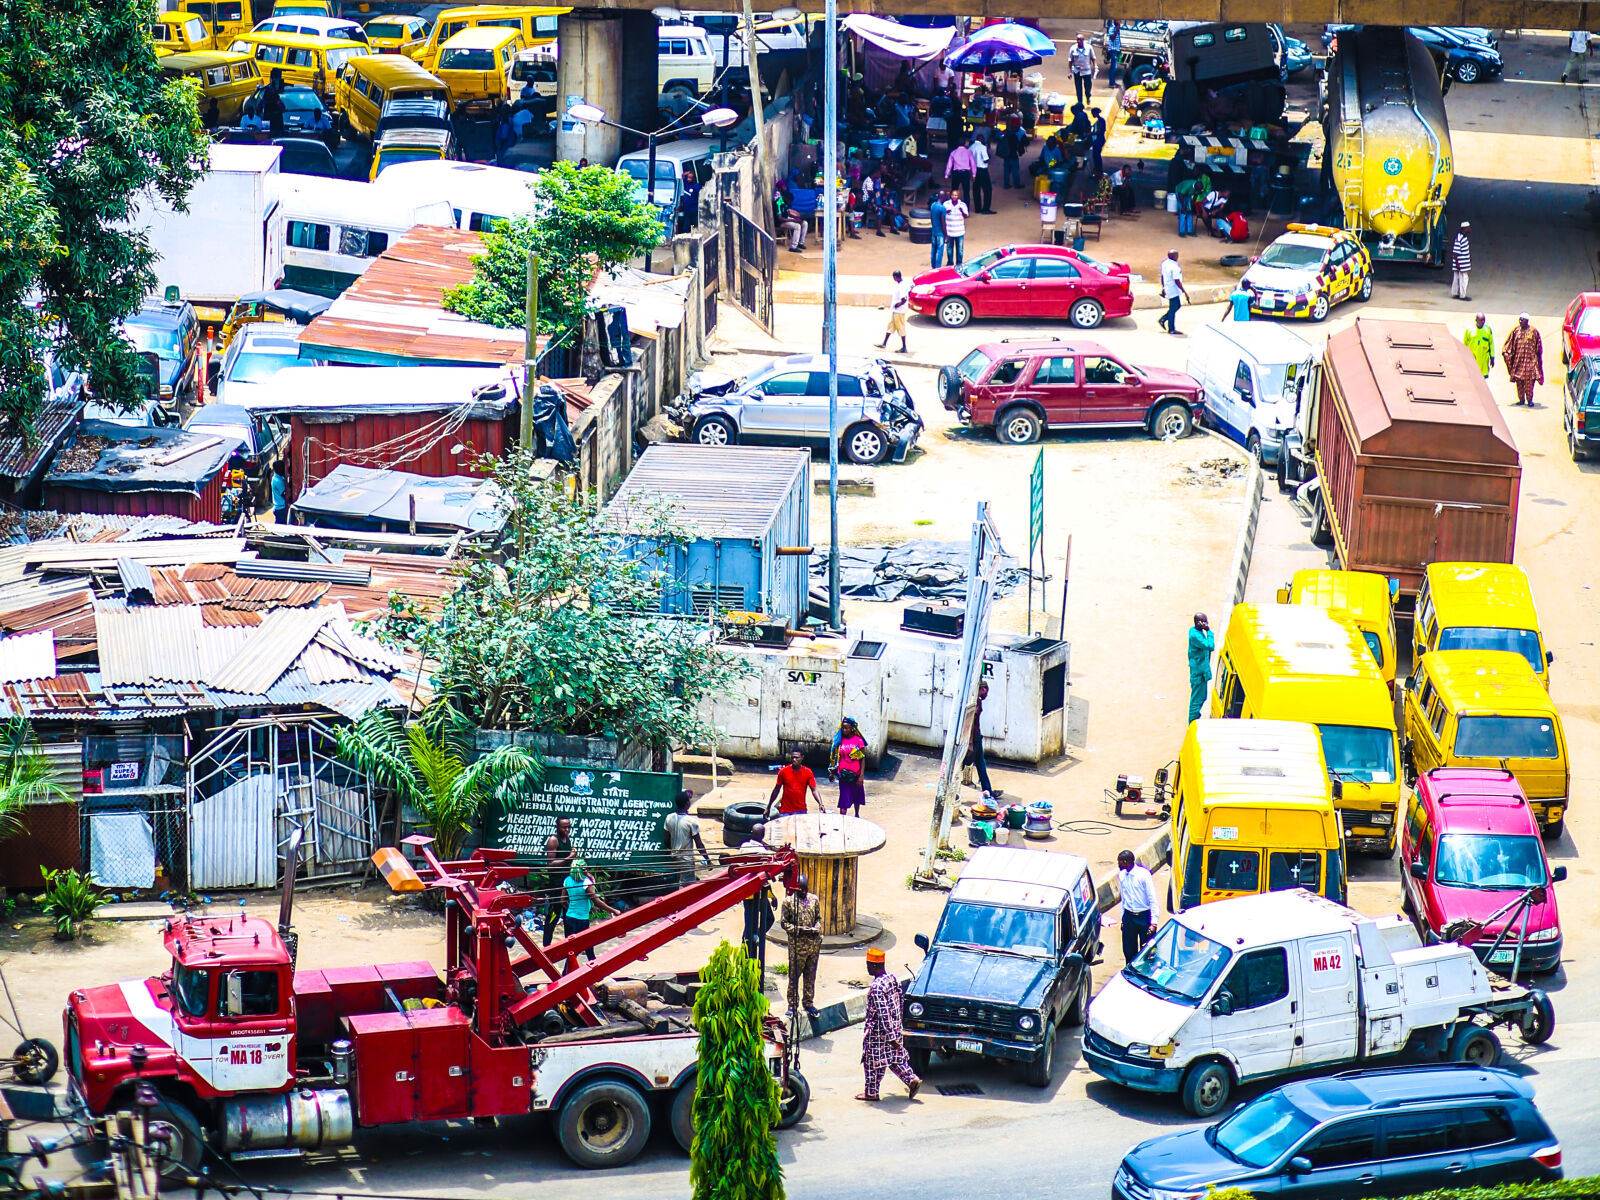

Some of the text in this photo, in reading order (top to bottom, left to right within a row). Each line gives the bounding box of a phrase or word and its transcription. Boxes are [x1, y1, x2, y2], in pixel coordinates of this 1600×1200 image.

[1438, 156, 1451, 174] 25
[543, 783, 630, 798] LAGOS STATE
[554, 794, 620, 808] ADMINISTRATION
[585, 806, 616, 816] ANNEX
[617, 808, 648, 817] OFFICE
[506, 813, 558, 826] REGISTRATI
[579, 818, 611, 829] MOTOR
[613, 820, 657, 832] VEHICLES
[506, 823, 558, 836] REGISTRATI
[580, 828, 612, 839] MOTOR
[613, 830, 651, 841] CYCLES
[505, 834, 544, 846] GENUINE
[587, 838, 623, 850] VEHICLE
[625, 840, 662, 852] LICENCE
[1314, 954, 1342, 972] MA 42
[230, 1050, 248, 1065] MA
[249, 1049, 263, 1065] 18
